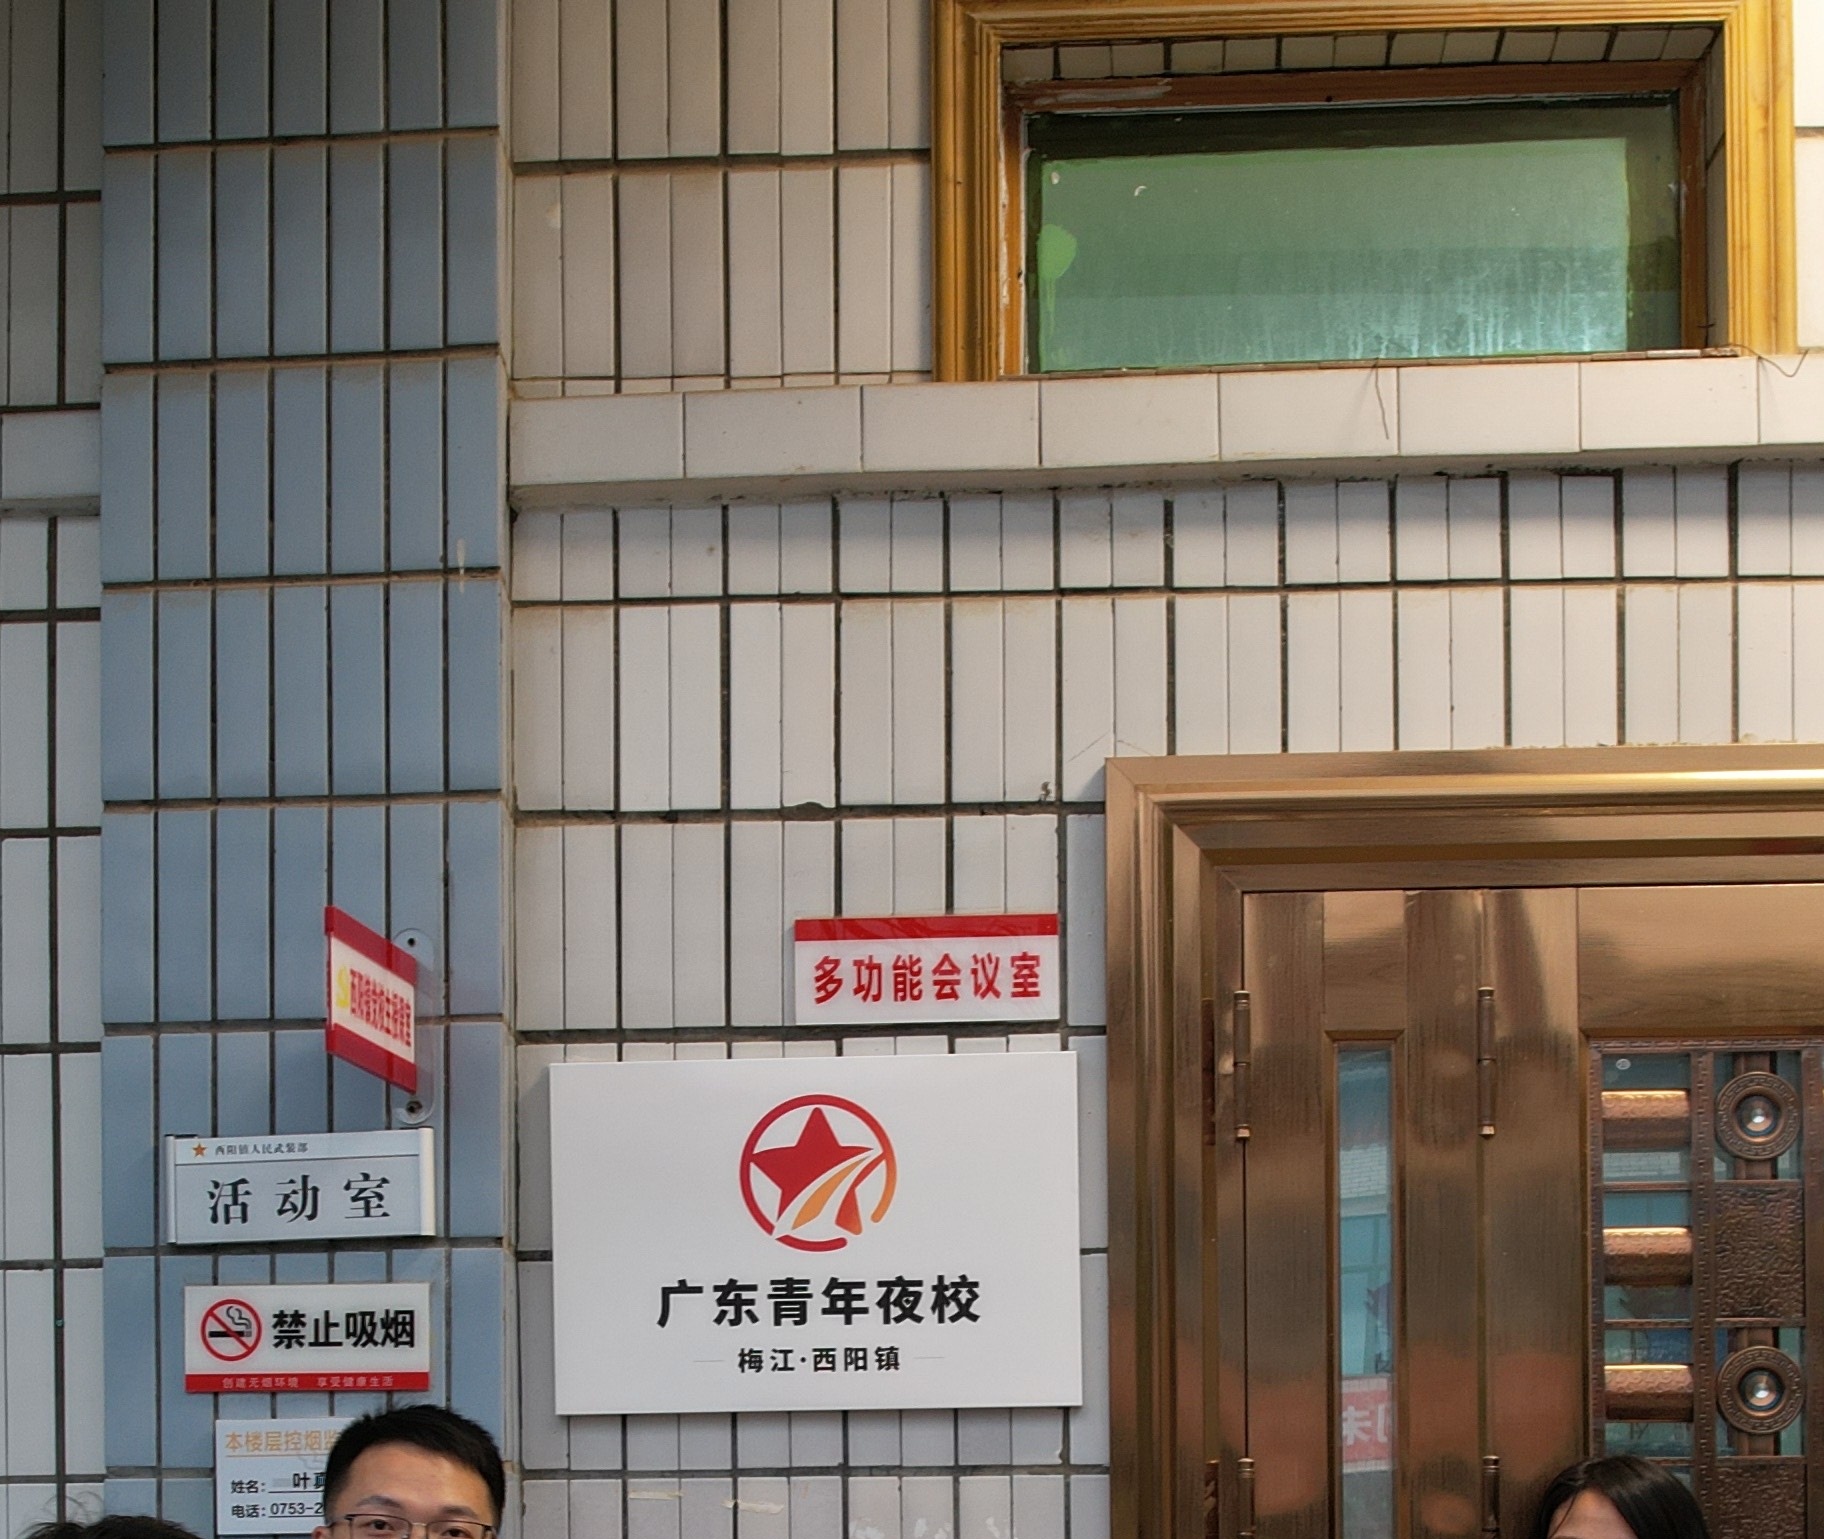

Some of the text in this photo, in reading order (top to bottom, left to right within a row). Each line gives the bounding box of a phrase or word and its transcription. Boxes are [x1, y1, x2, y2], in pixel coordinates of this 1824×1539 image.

[813, 951, 1041, 1005] 多功能会议室
[214, 1142, 309, 1156] 西阳镇人民武装部
[207, 1172, 391, 1225] 活动室
[656, 1273, 981, 1328] 广东青年夜校
[272, 1309, 416, 1350] 禁止吸烟
[737, 1345, 901, 1373] 梅江·西阳镇
[222, 1375, 394, 1389] 创建无烟环境 享受健康生活
